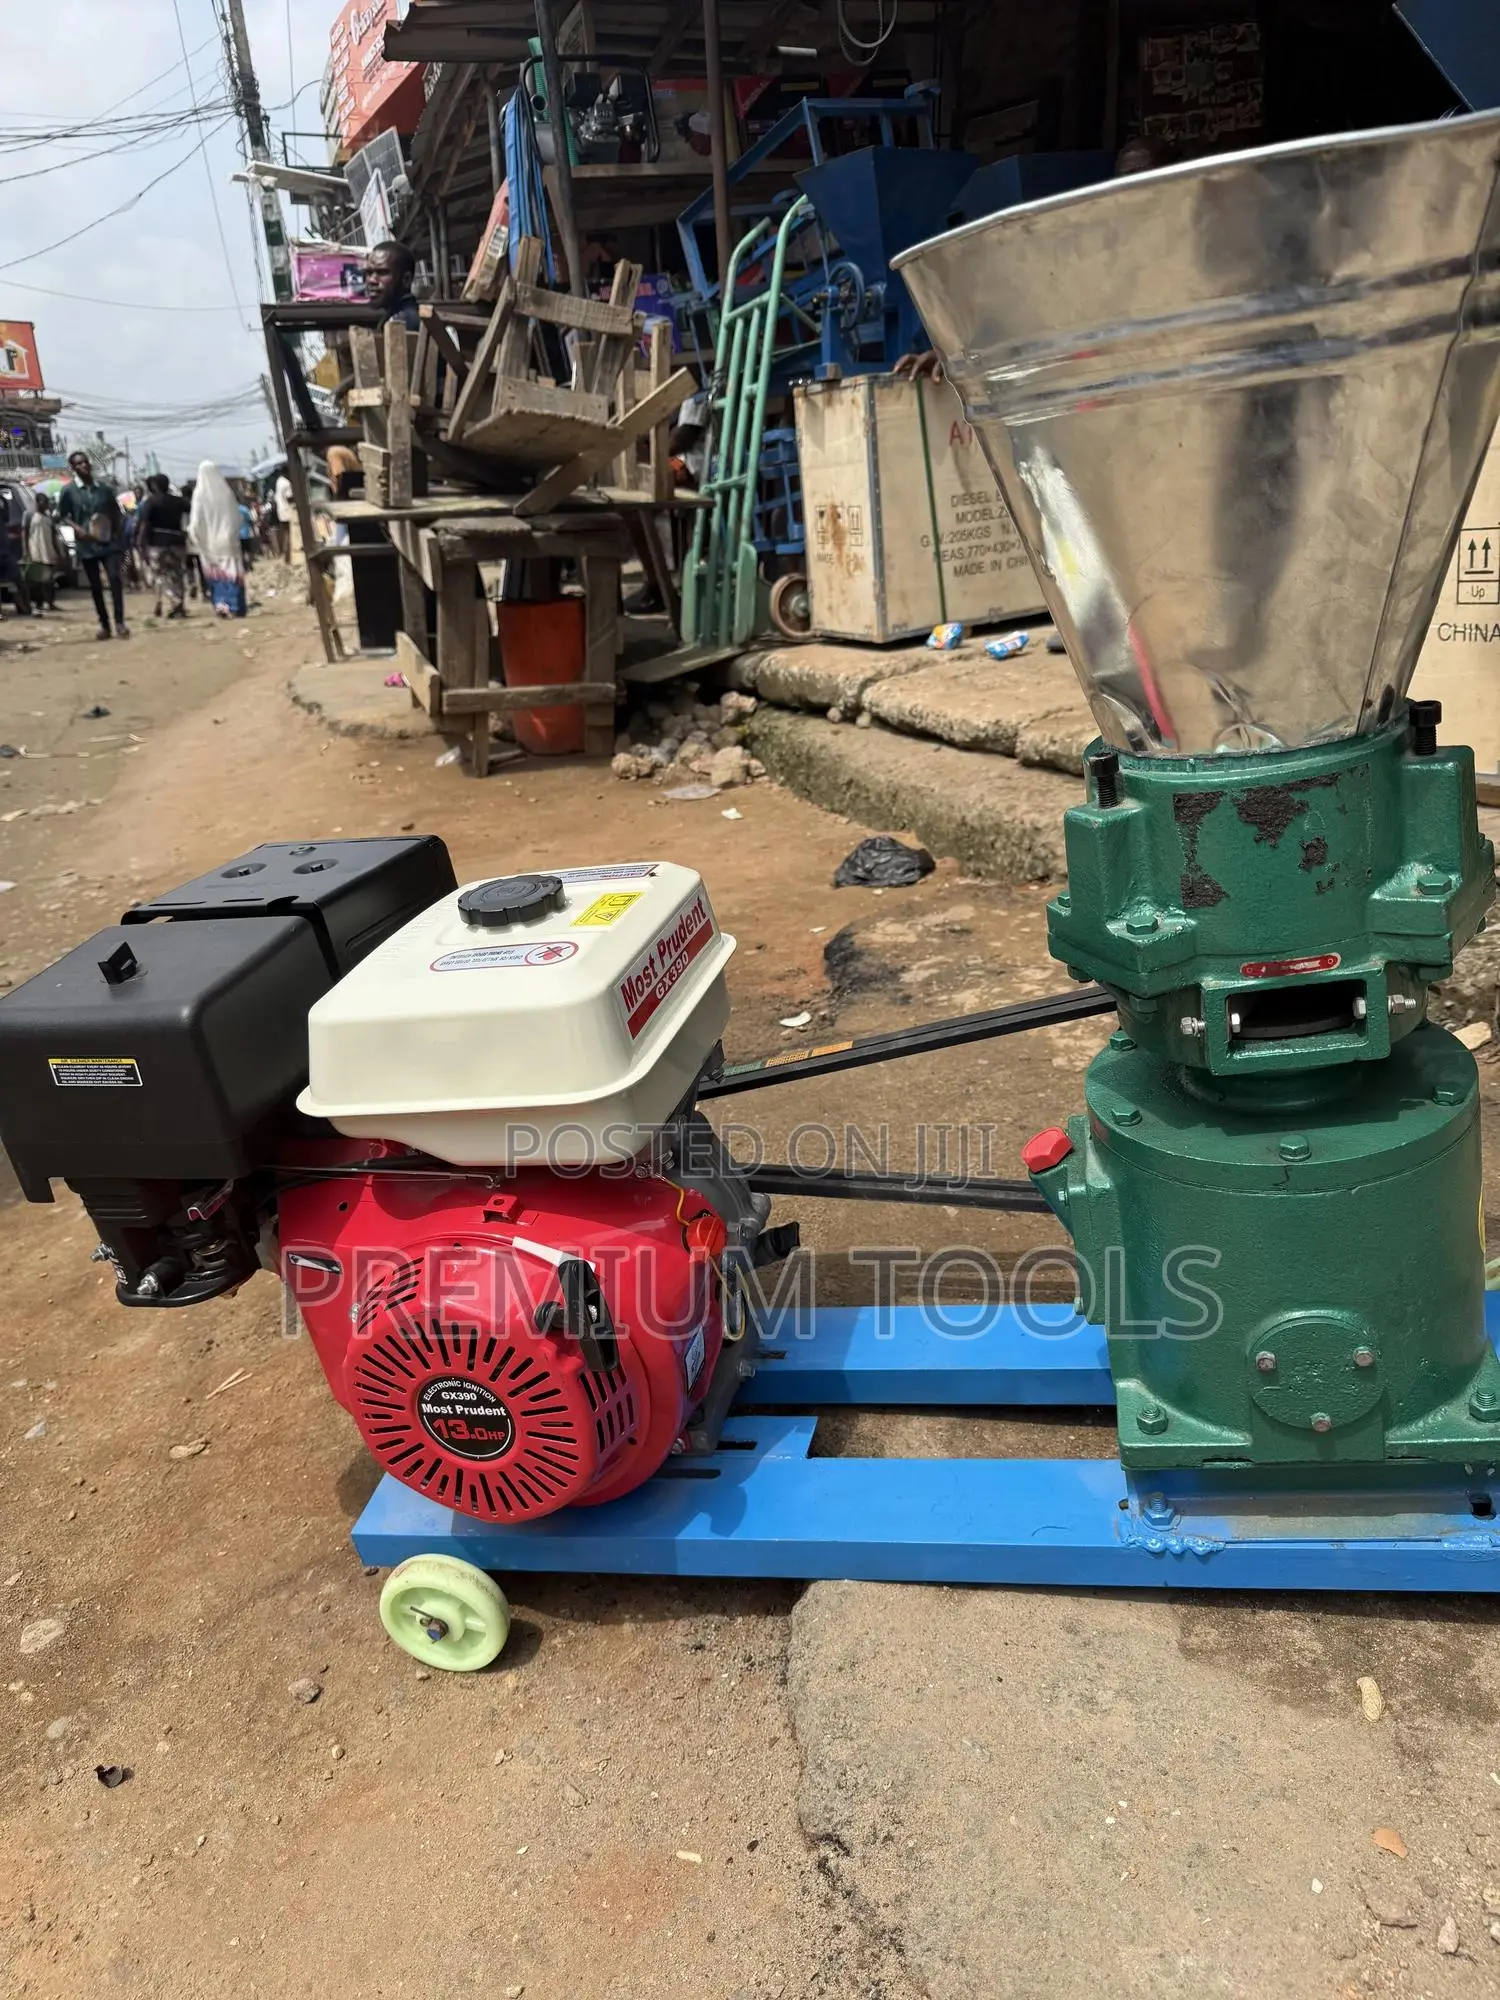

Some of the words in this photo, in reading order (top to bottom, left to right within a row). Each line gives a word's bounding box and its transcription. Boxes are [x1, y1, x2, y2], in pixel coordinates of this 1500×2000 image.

[951, 491, 991, 508] DIESEL
[953, 561, 985, 578] MADE
[990, 558, 1002, 572] IN
[1471, 585, 1485, 600] Up
[620, 952, 658, 1013] Most
[656, 896, 707, 969] Prudent
[655, 950, 689, 999] GX390
[423, 1380, 462, 1401] ELECTRONIC
[463, 1381, 497, 1403] IGNITION
[441, 1391, 477, 1401] GX390
[421, 1403, 453, 1414] Most
[455, 1404, 507, 1416] Prudent
